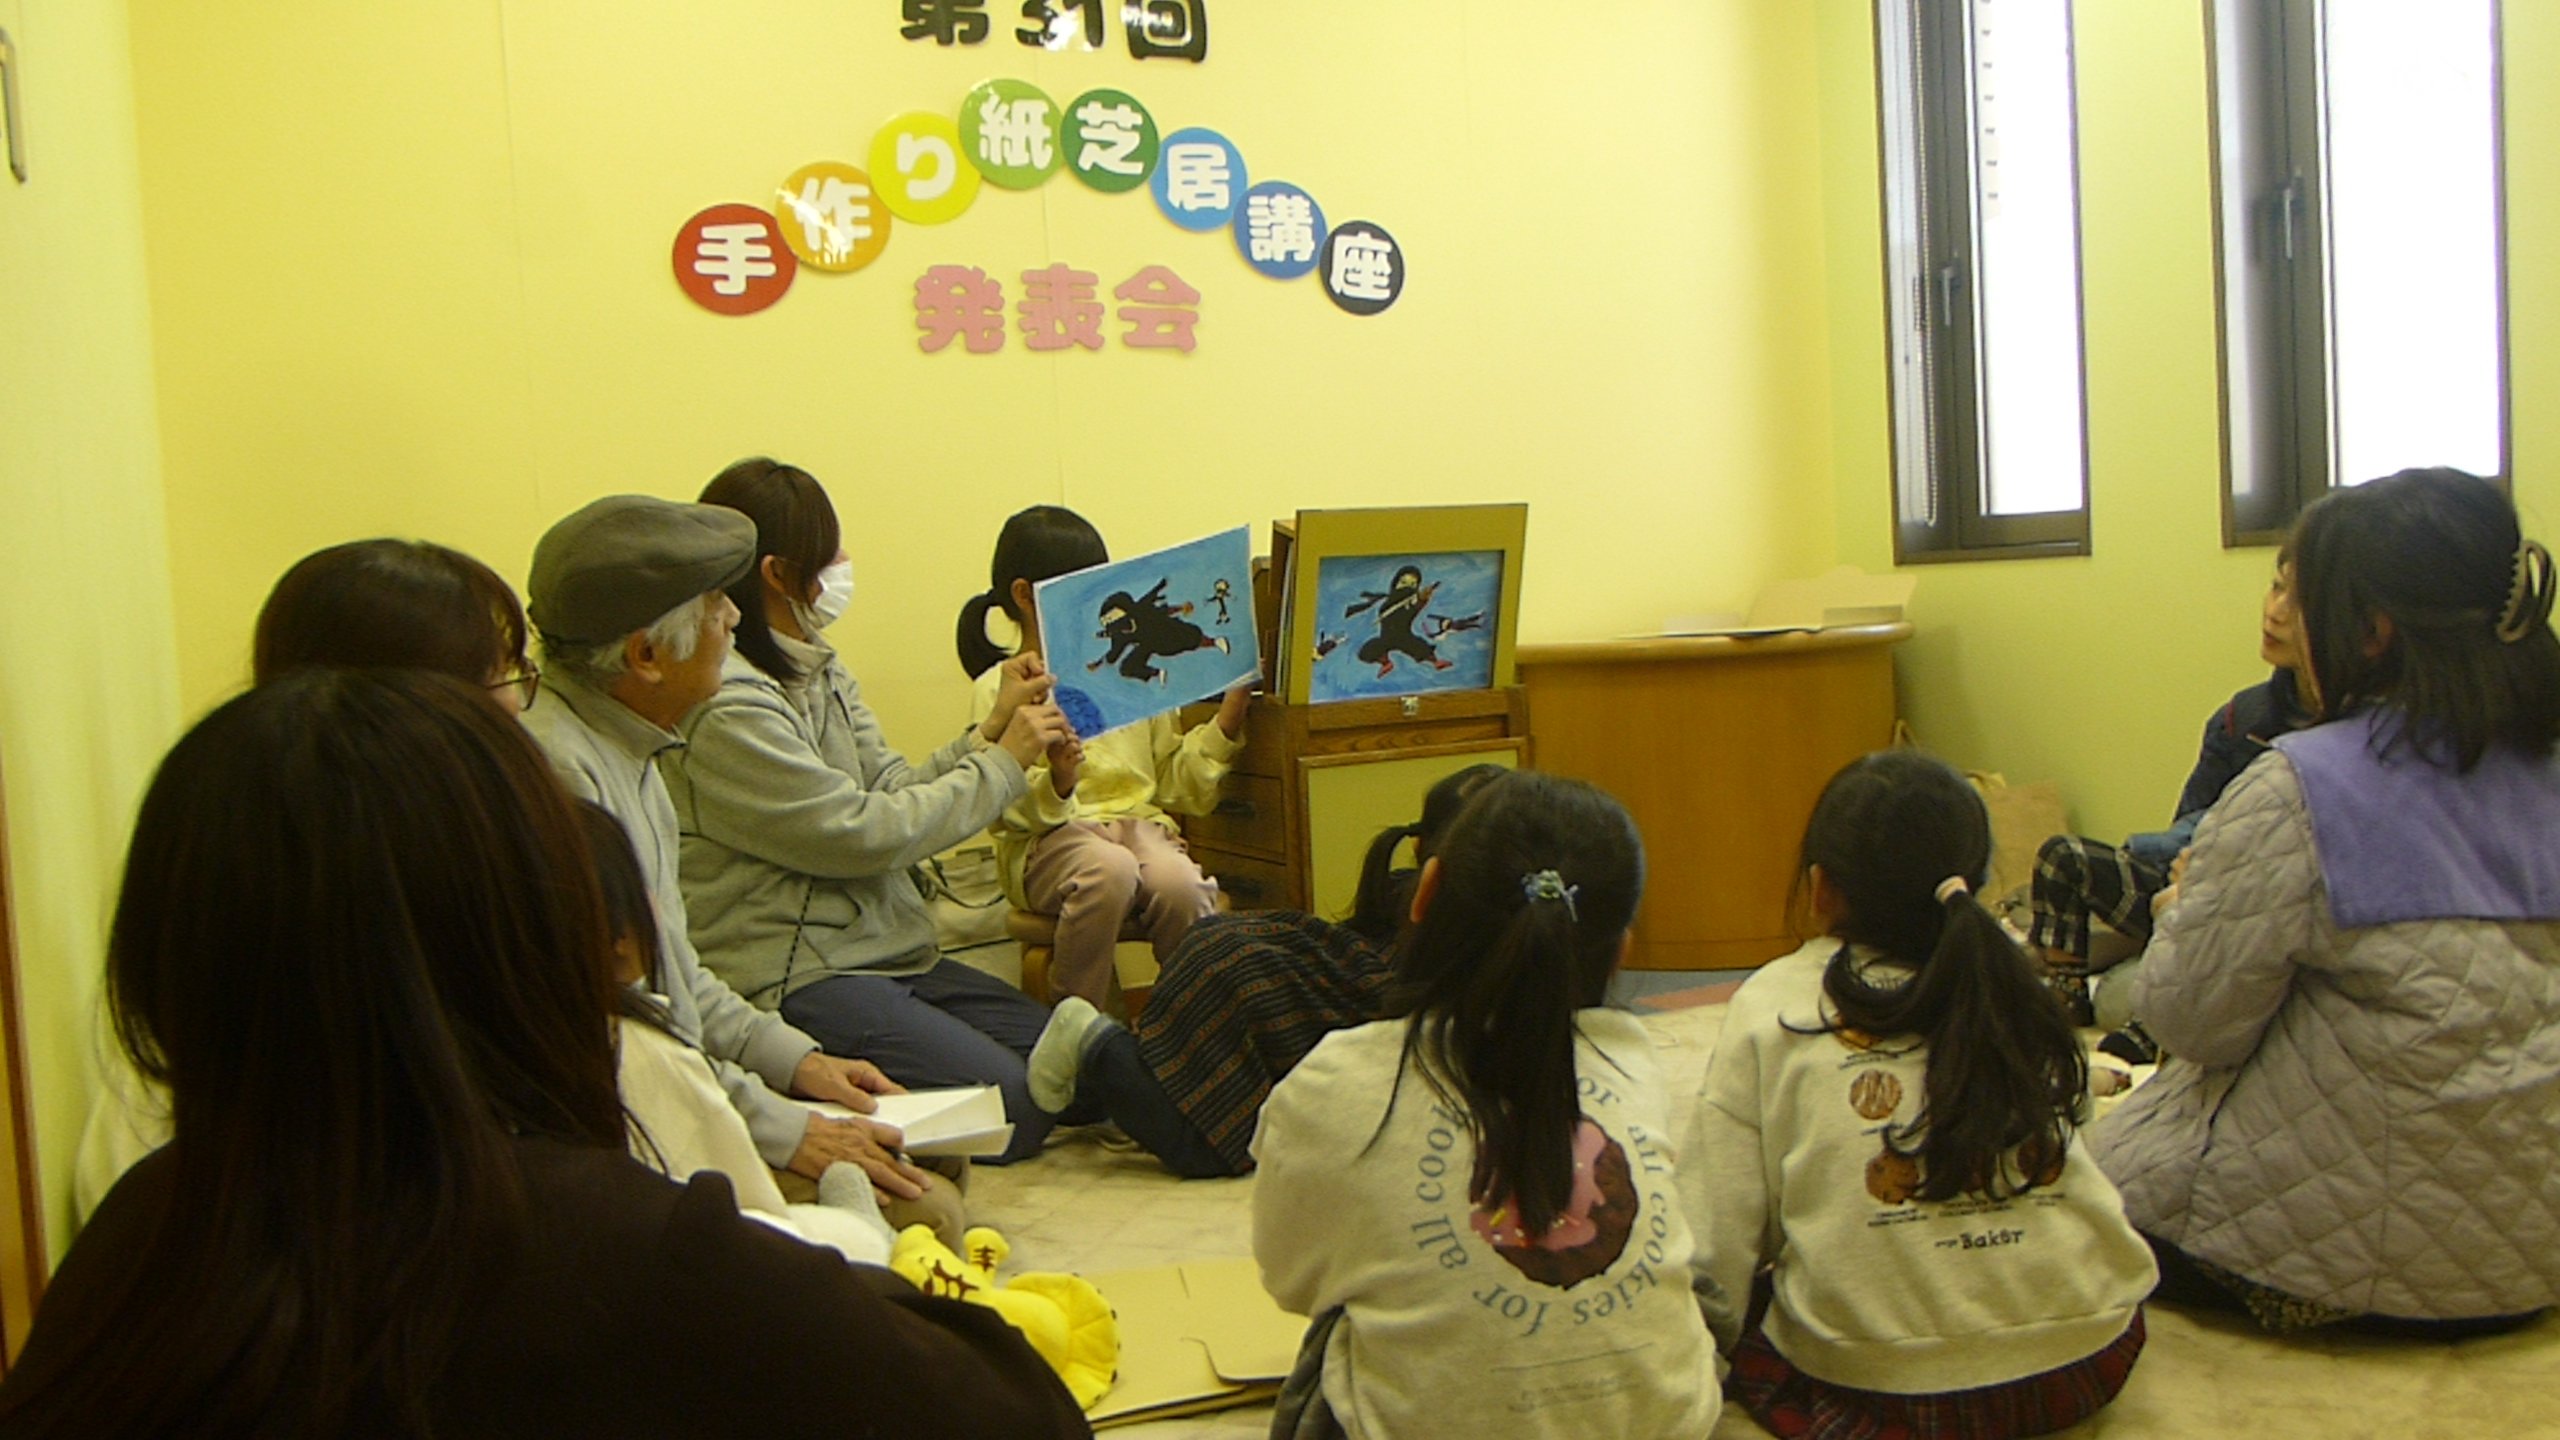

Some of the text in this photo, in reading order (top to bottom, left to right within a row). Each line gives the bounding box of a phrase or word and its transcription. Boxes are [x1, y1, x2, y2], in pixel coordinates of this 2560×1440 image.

[694, 99, 1393, 302] 手作り紙芝居講座
[914, 263, 1201, 354] 発表会
[1576, 1076, 1623, 1107] or
[1410, 1215, 1469, 1269] all
[1572, 1191, 1667, 1325] cookies
[1472, 1283, 1551, 1337] for
